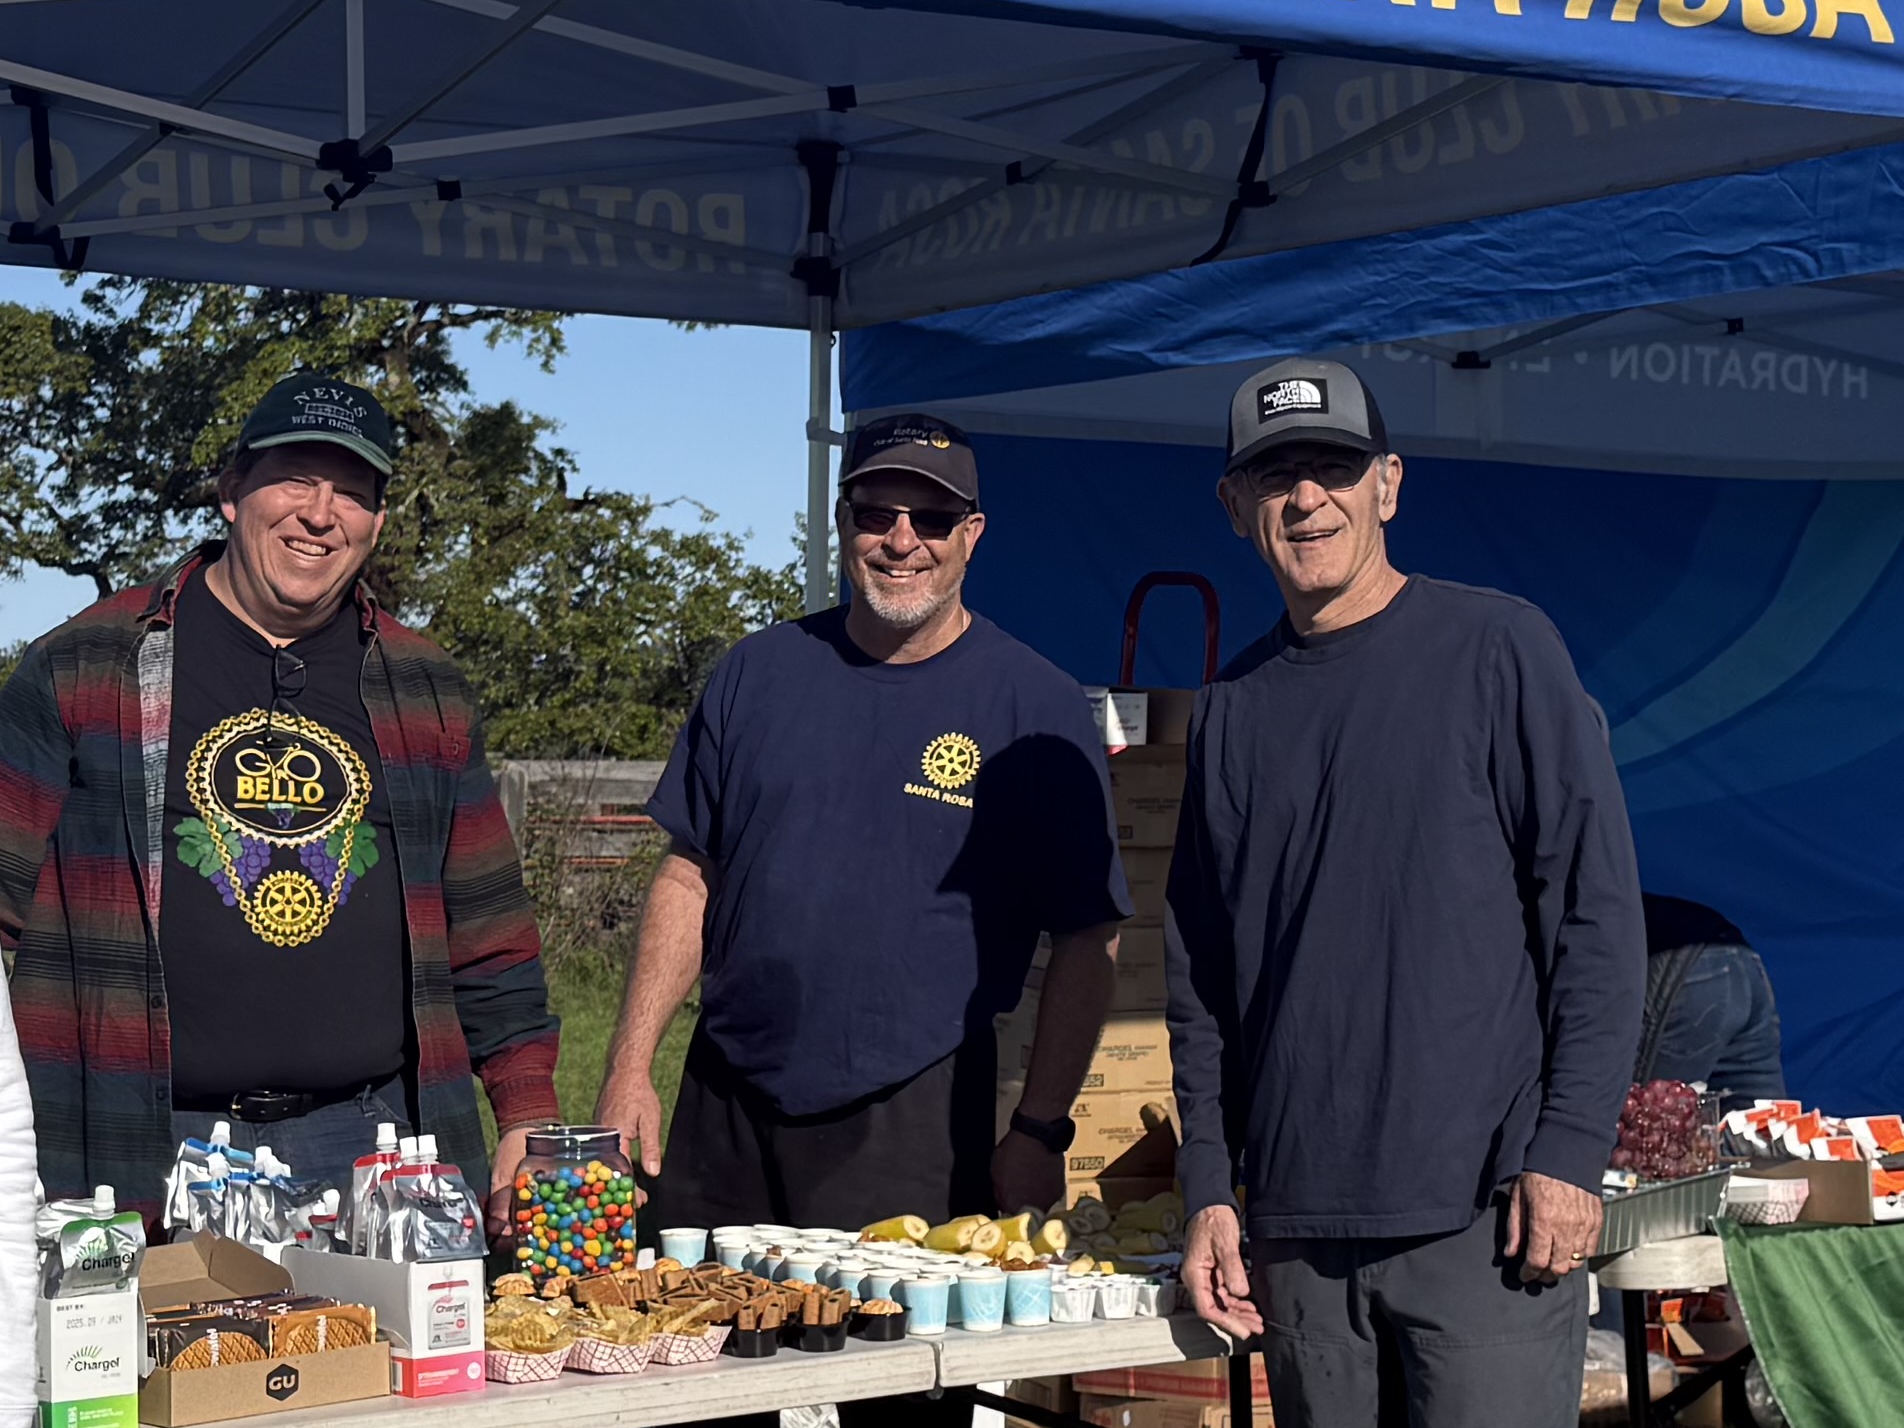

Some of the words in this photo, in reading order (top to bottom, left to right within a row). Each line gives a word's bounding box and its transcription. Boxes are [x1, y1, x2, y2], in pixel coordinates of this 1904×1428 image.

[293, 387, 368, 418] NEVIS
[292, 415, 324, 425] WEST
[236, 775, 325, 804] BELLO
[903, 782, 940, 800] SANTA
[941, 792, 974, 808] ROSA
[73, 1357, 121, 1372] Chargel
[268, 1374, 296, 1391] GU
